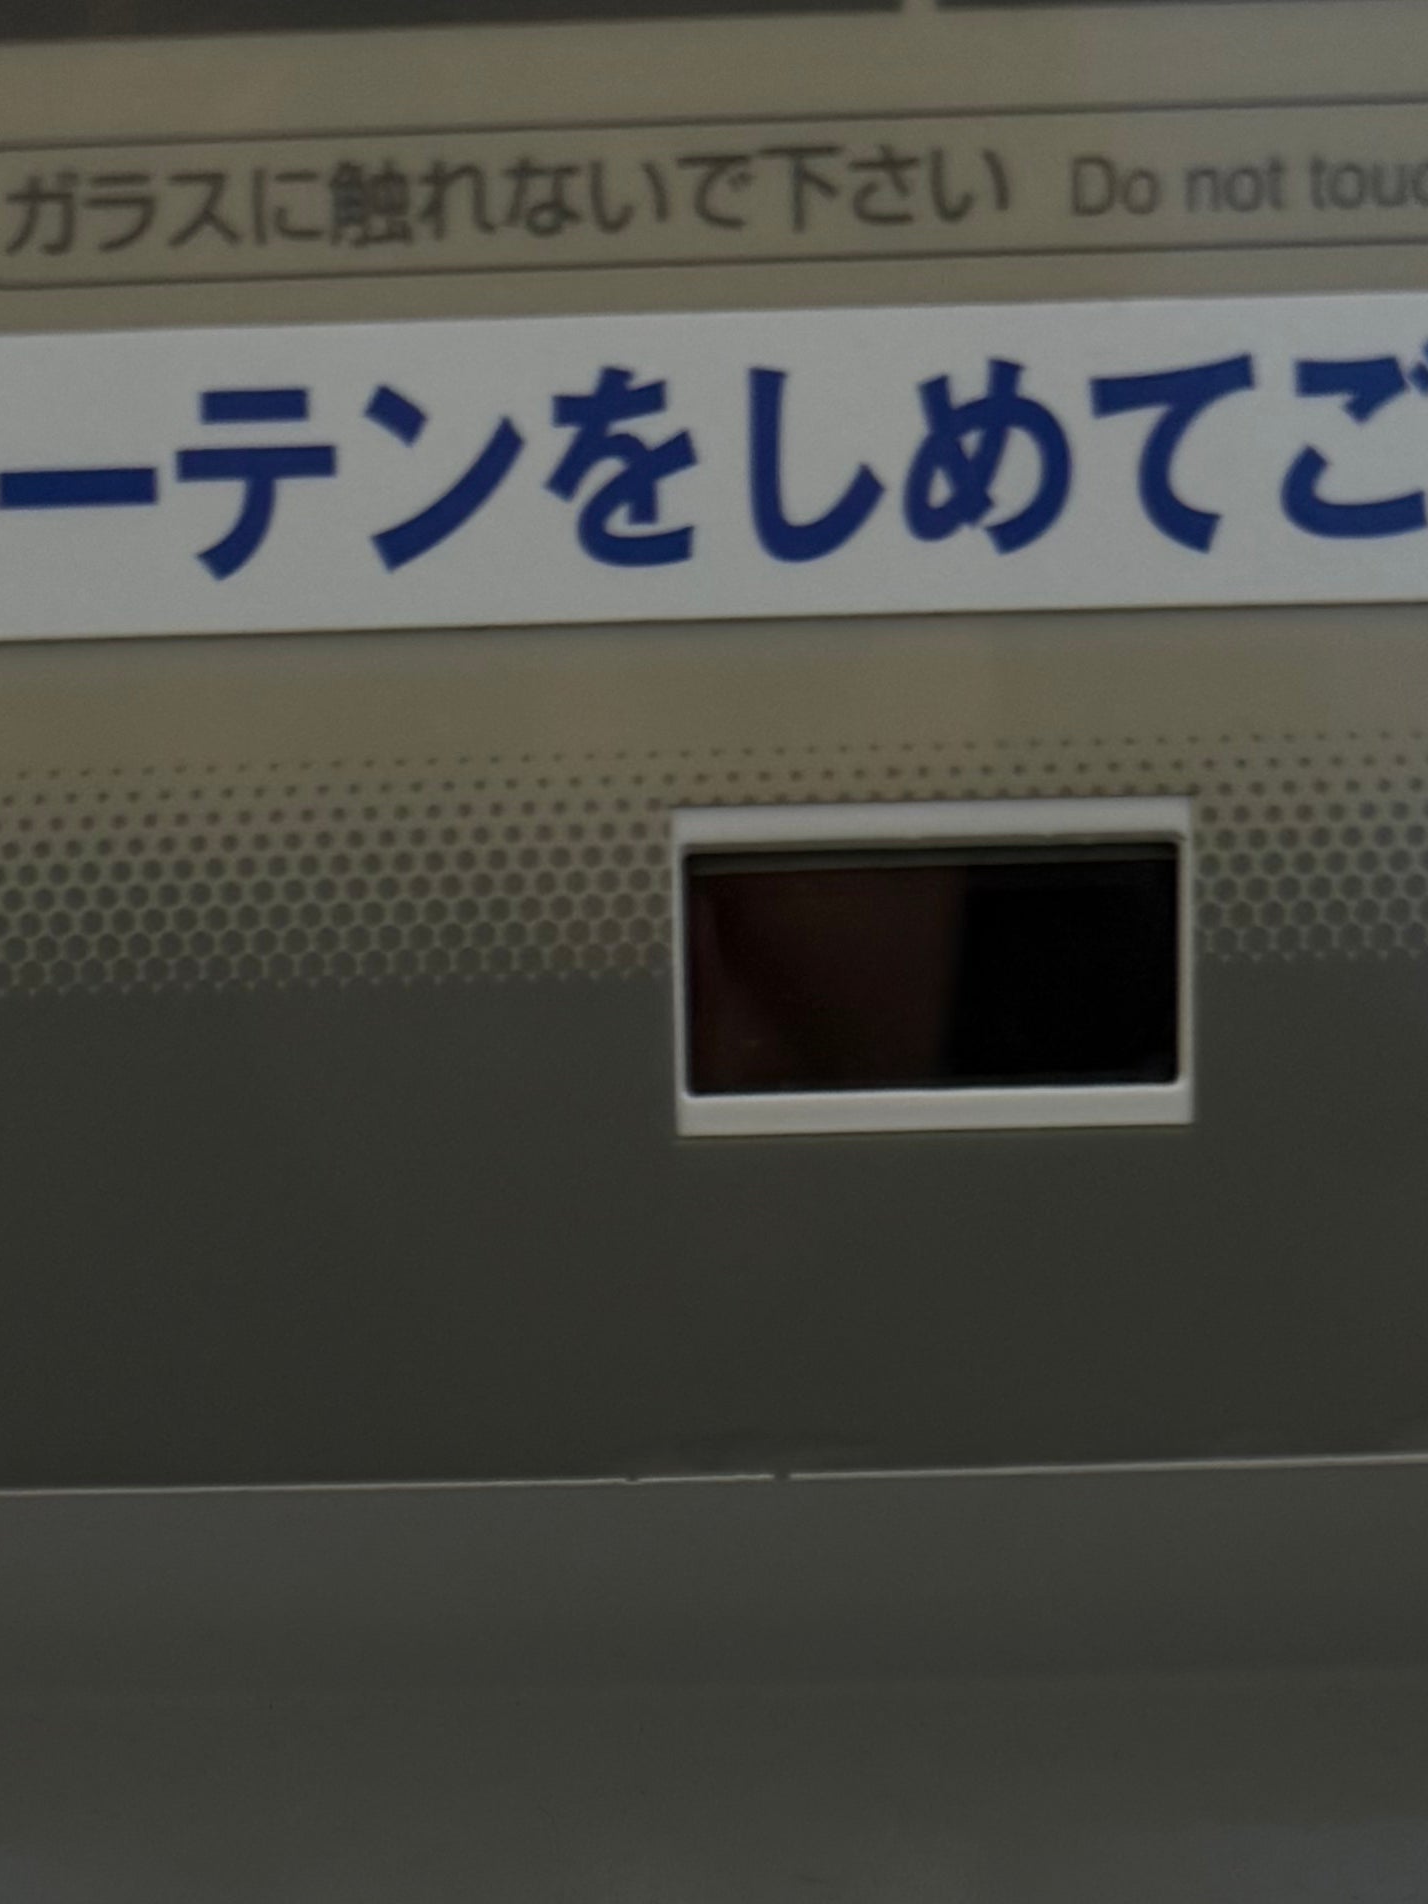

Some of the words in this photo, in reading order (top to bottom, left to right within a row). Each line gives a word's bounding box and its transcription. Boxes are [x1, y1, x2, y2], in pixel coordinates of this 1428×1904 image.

[3, 146, 1010, 257] ガラスに触れないで下さい
[1069, 154, 1160, 217] Do
[1183, 156, 1286, 214] not
